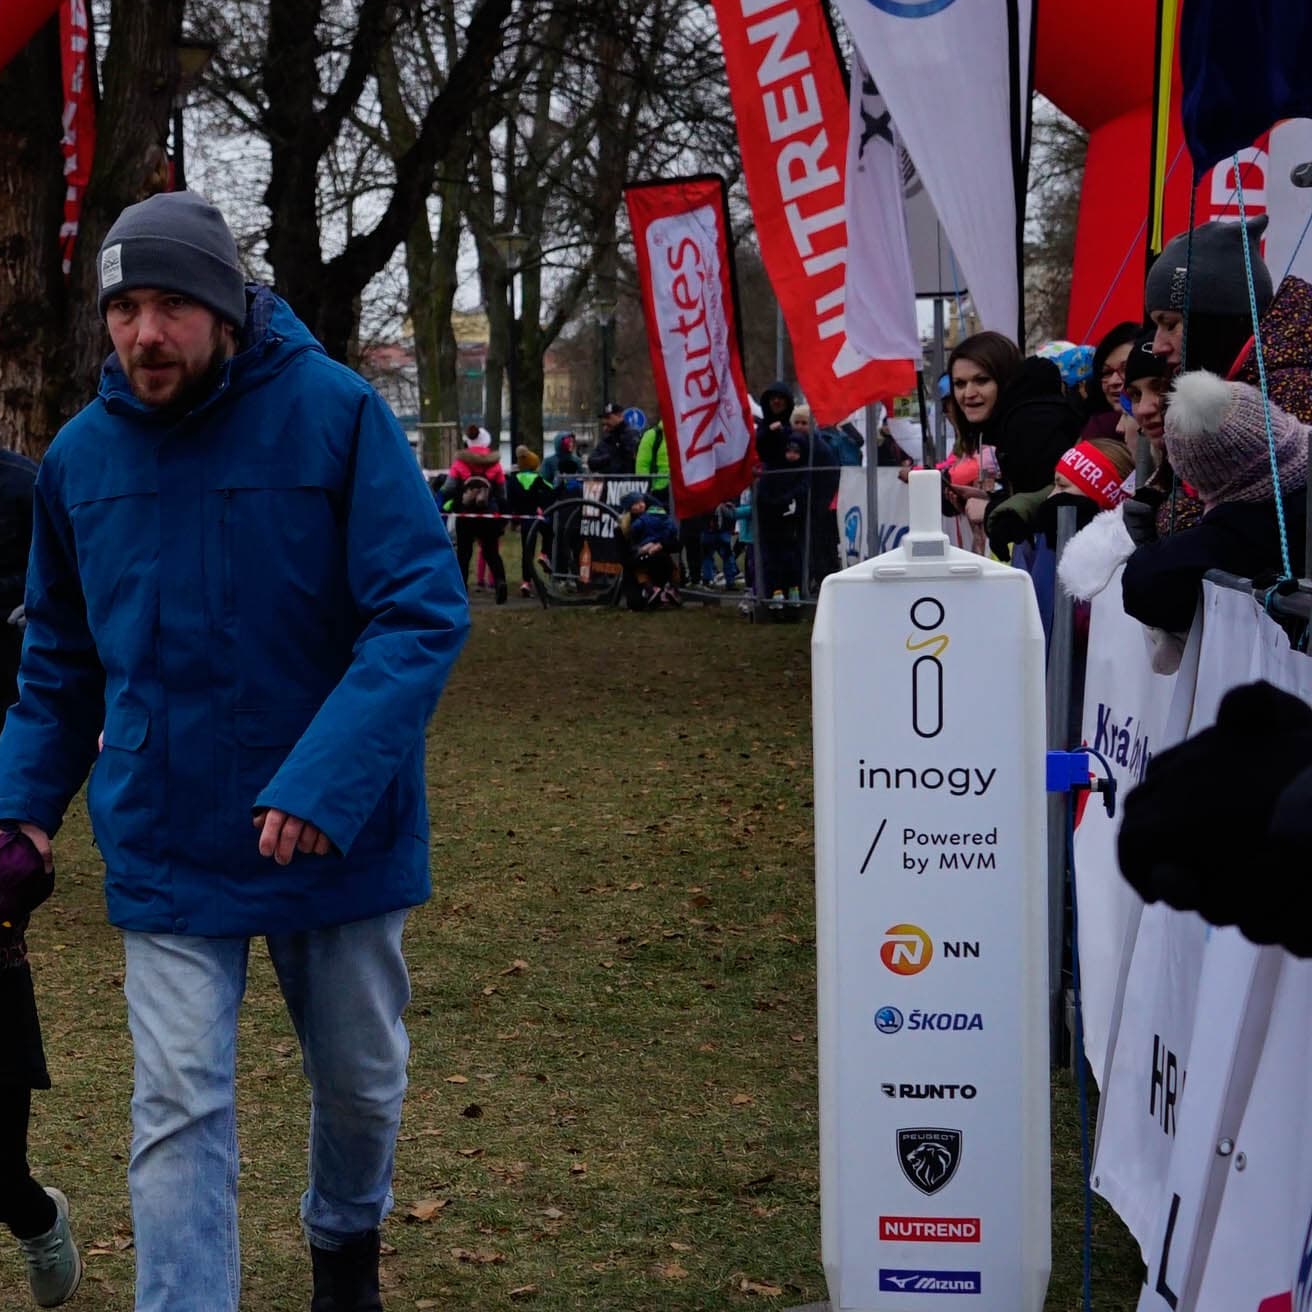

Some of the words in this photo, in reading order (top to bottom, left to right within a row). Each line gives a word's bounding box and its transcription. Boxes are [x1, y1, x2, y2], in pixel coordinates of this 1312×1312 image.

[667, 236, 727, 462] Nartes
[859, 759, 997, 796] innogy
[903, 827, 998, 846] Powered
[903, 851, 929, 874] by
[939, 852, 997, 870] MVM
[943, 941, 980, 958] NN
[907, 1008, 984, 1032] ŠKODA
[899, 1083, 977, 1100] RUNTO
[885, 1220, 977, 1238] NUTREND
